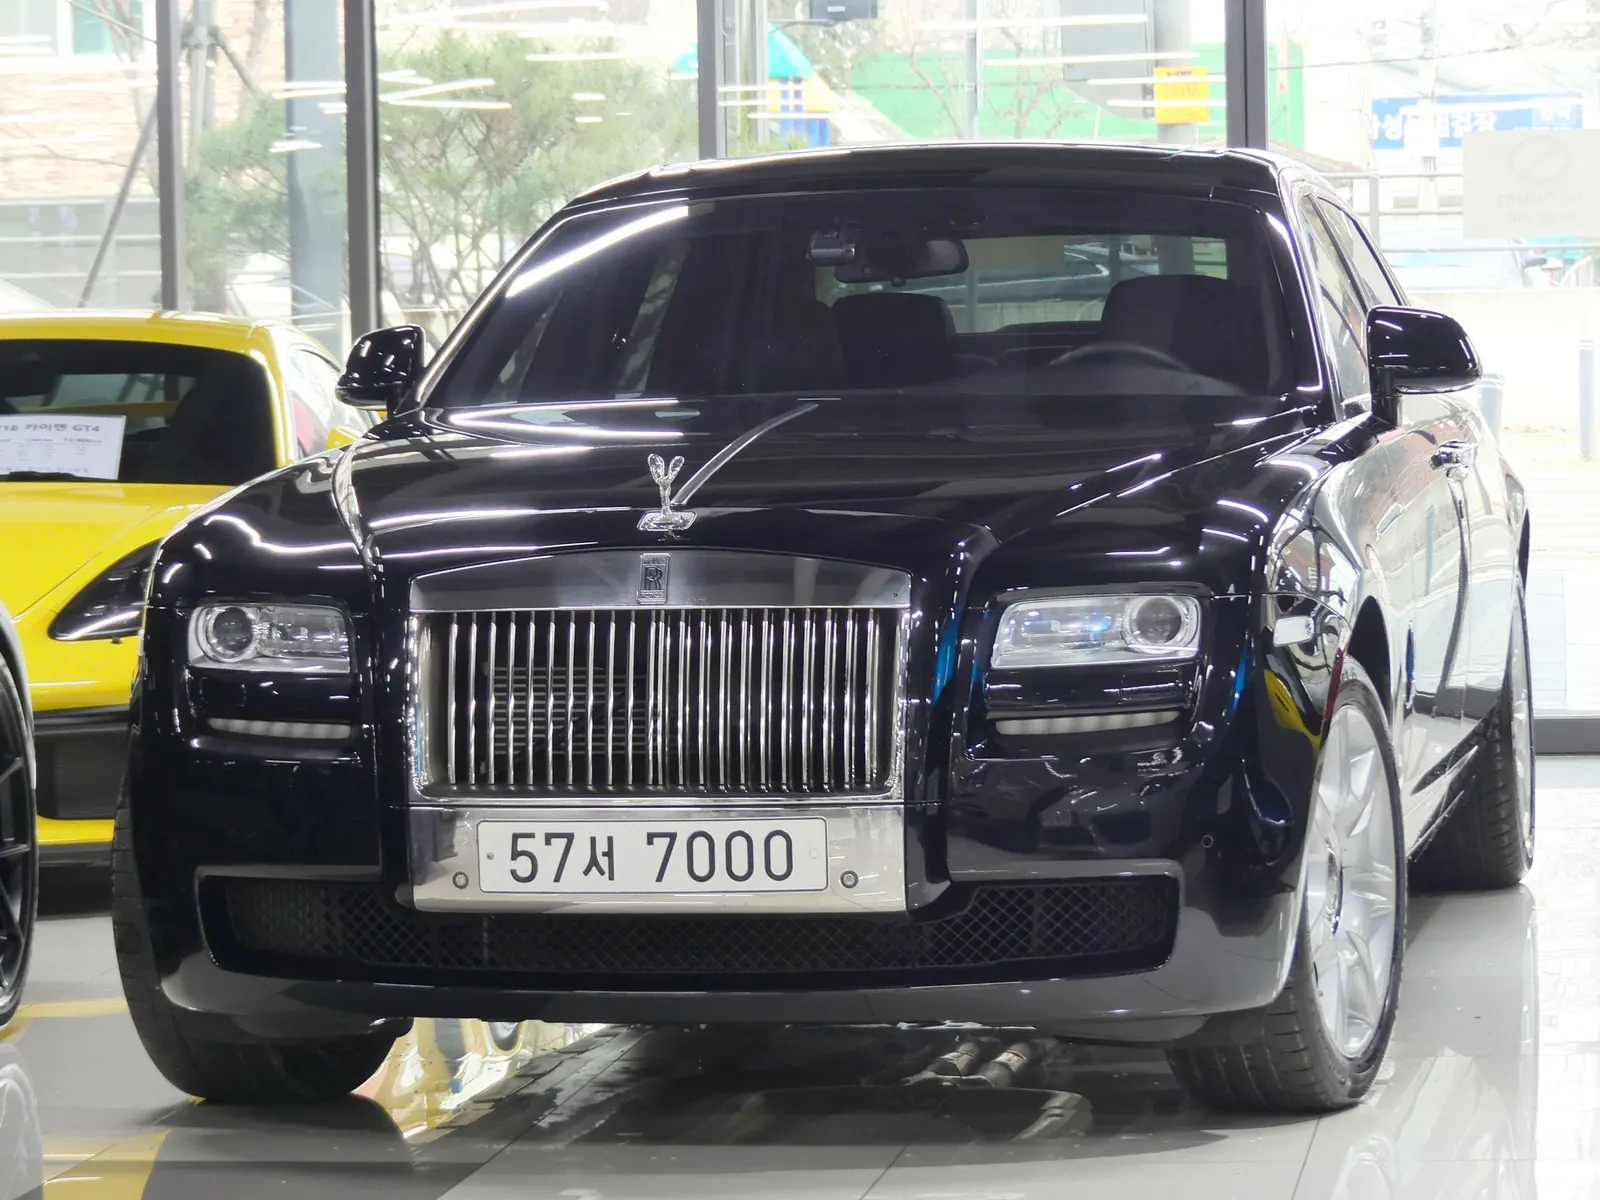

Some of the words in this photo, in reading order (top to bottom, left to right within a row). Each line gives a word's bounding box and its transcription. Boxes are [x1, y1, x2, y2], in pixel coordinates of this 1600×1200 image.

[72, 424, 100, 432] GT4
[509, 831, 616, 884] 57서
[645, 829, 794, 883] 7000
